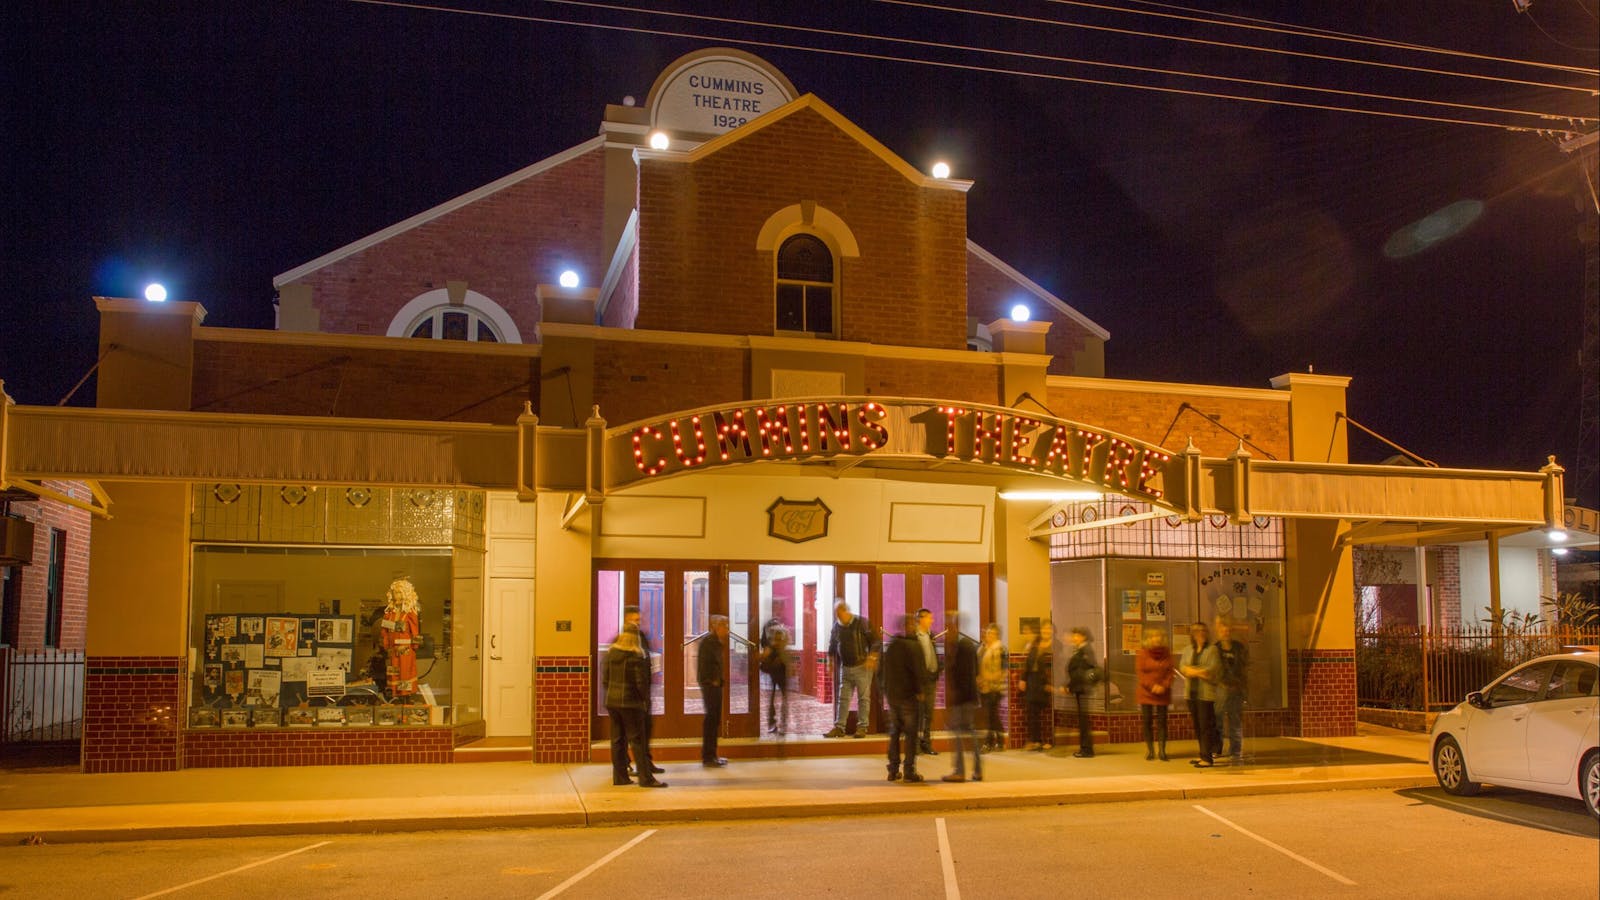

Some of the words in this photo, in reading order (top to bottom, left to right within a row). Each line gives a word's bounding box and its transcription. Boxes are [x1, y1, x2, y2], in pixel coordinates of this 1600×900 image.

[689, 75, 764, 95] CUMMINS
[693, 94, 761, 113] THEATRE
[632, 402, 889, 476] CUMMINS
[937, 404, 1171, 498] THEATRE
